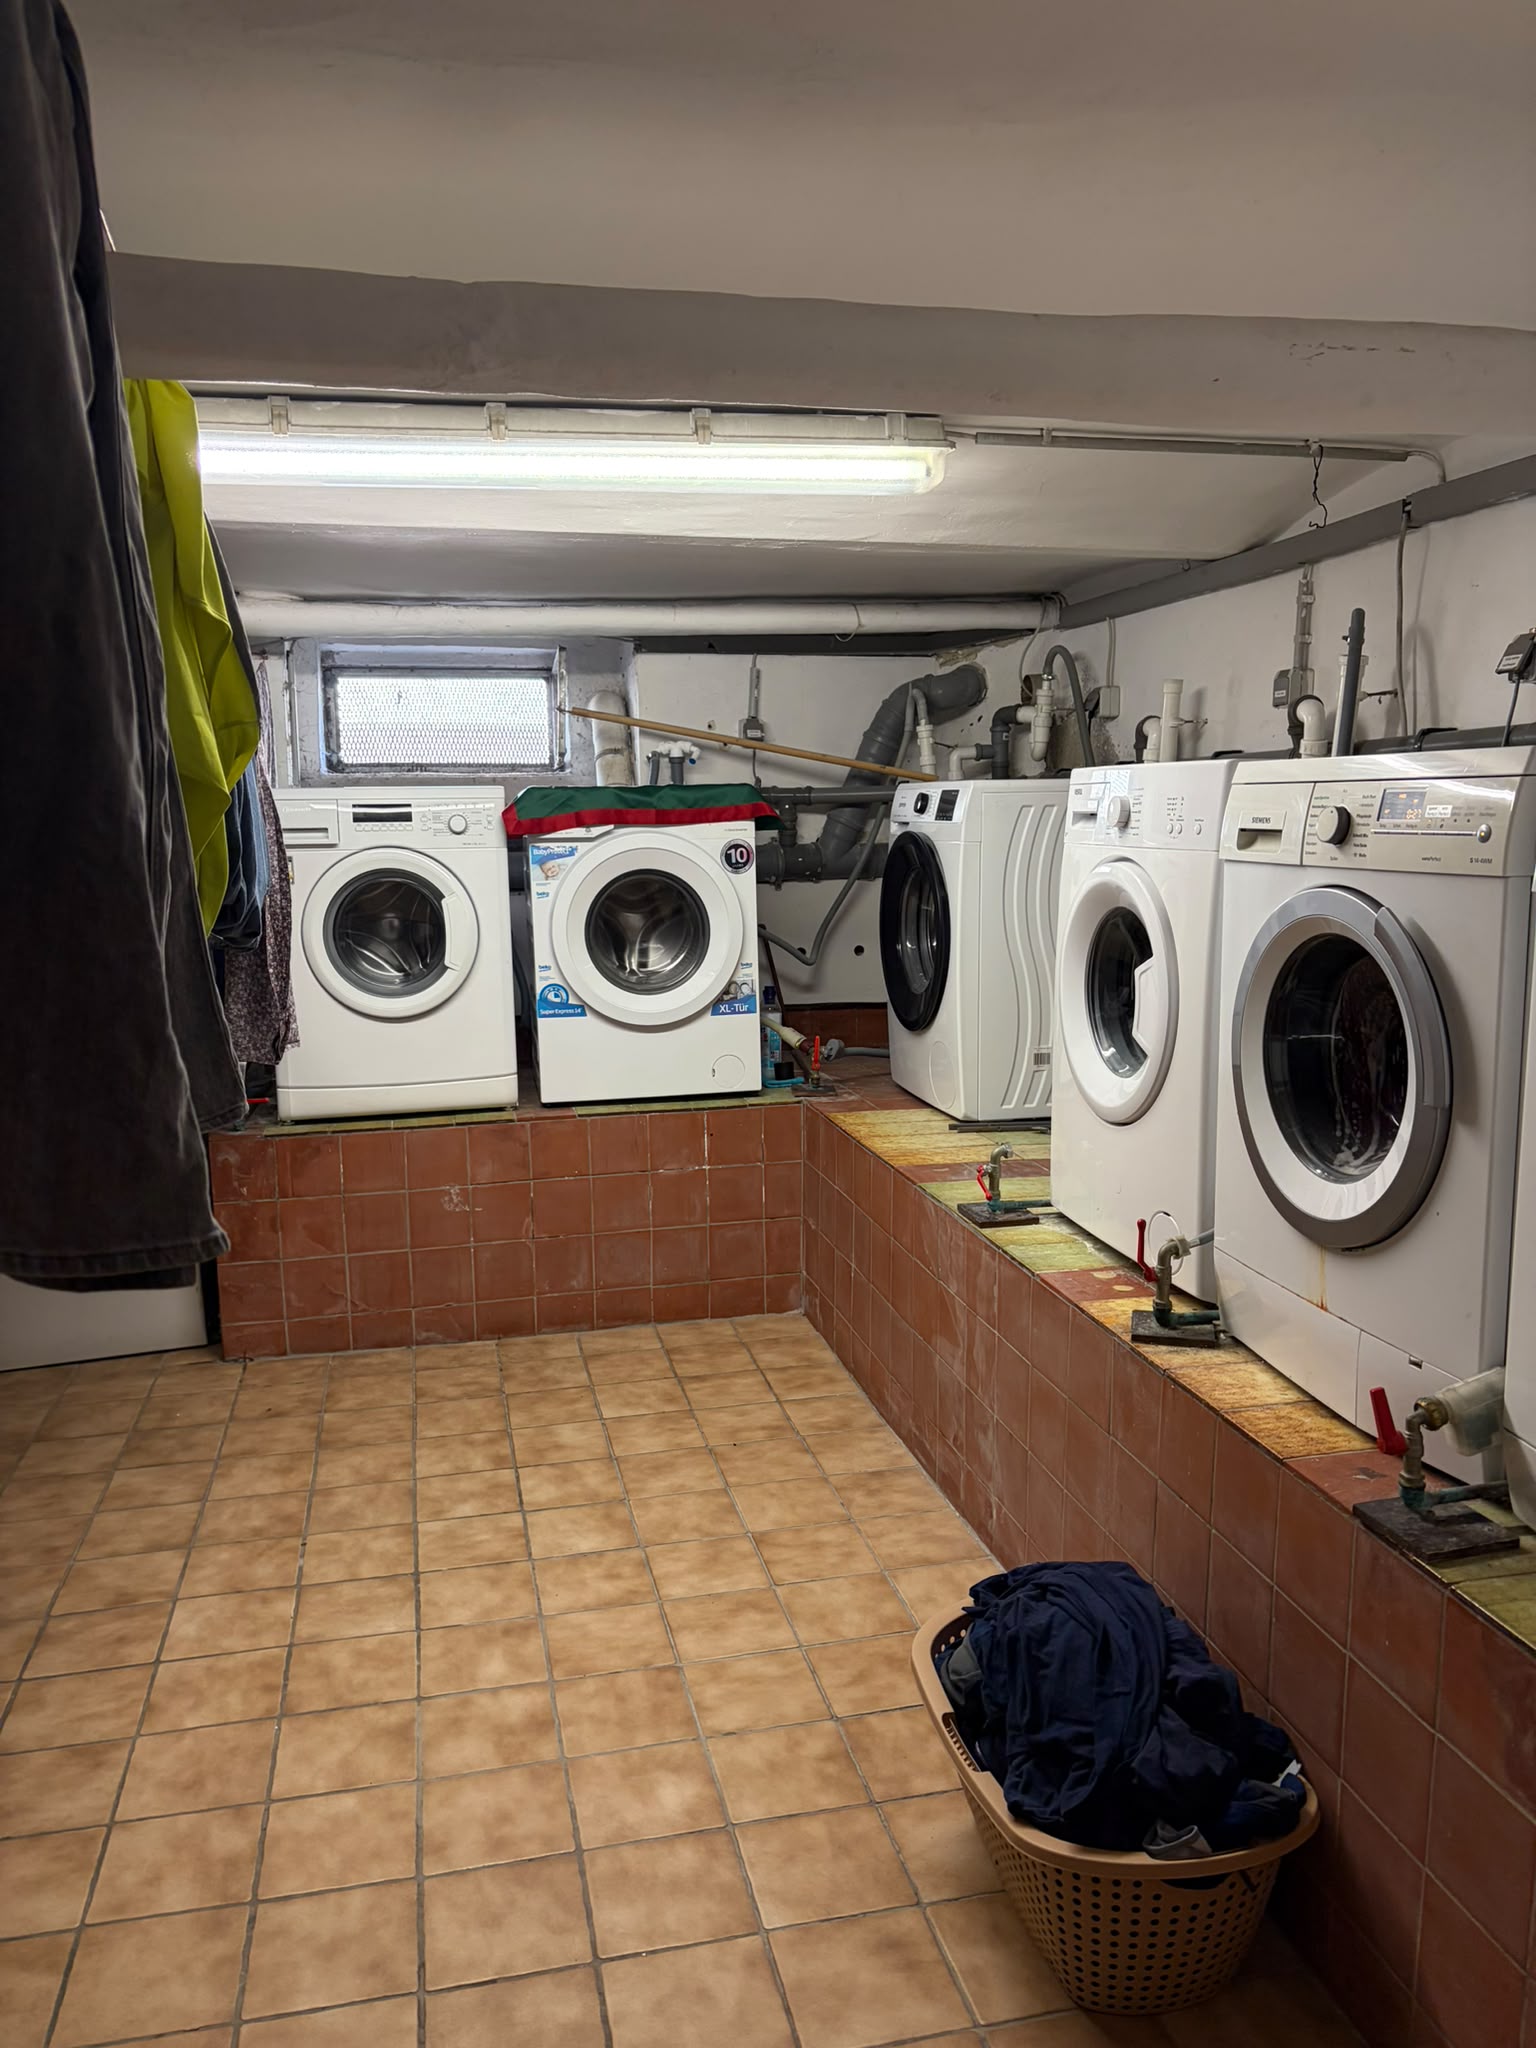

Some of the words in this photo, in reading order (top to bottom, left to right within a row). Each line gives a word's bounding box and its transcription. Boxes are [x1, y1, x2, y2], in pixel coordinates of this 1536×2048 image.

[1251, 816, 1271, 824] SIEMENS
[727, 847, 748, 864] 10
[719, 1002, 749, 1013] XL-Tür
